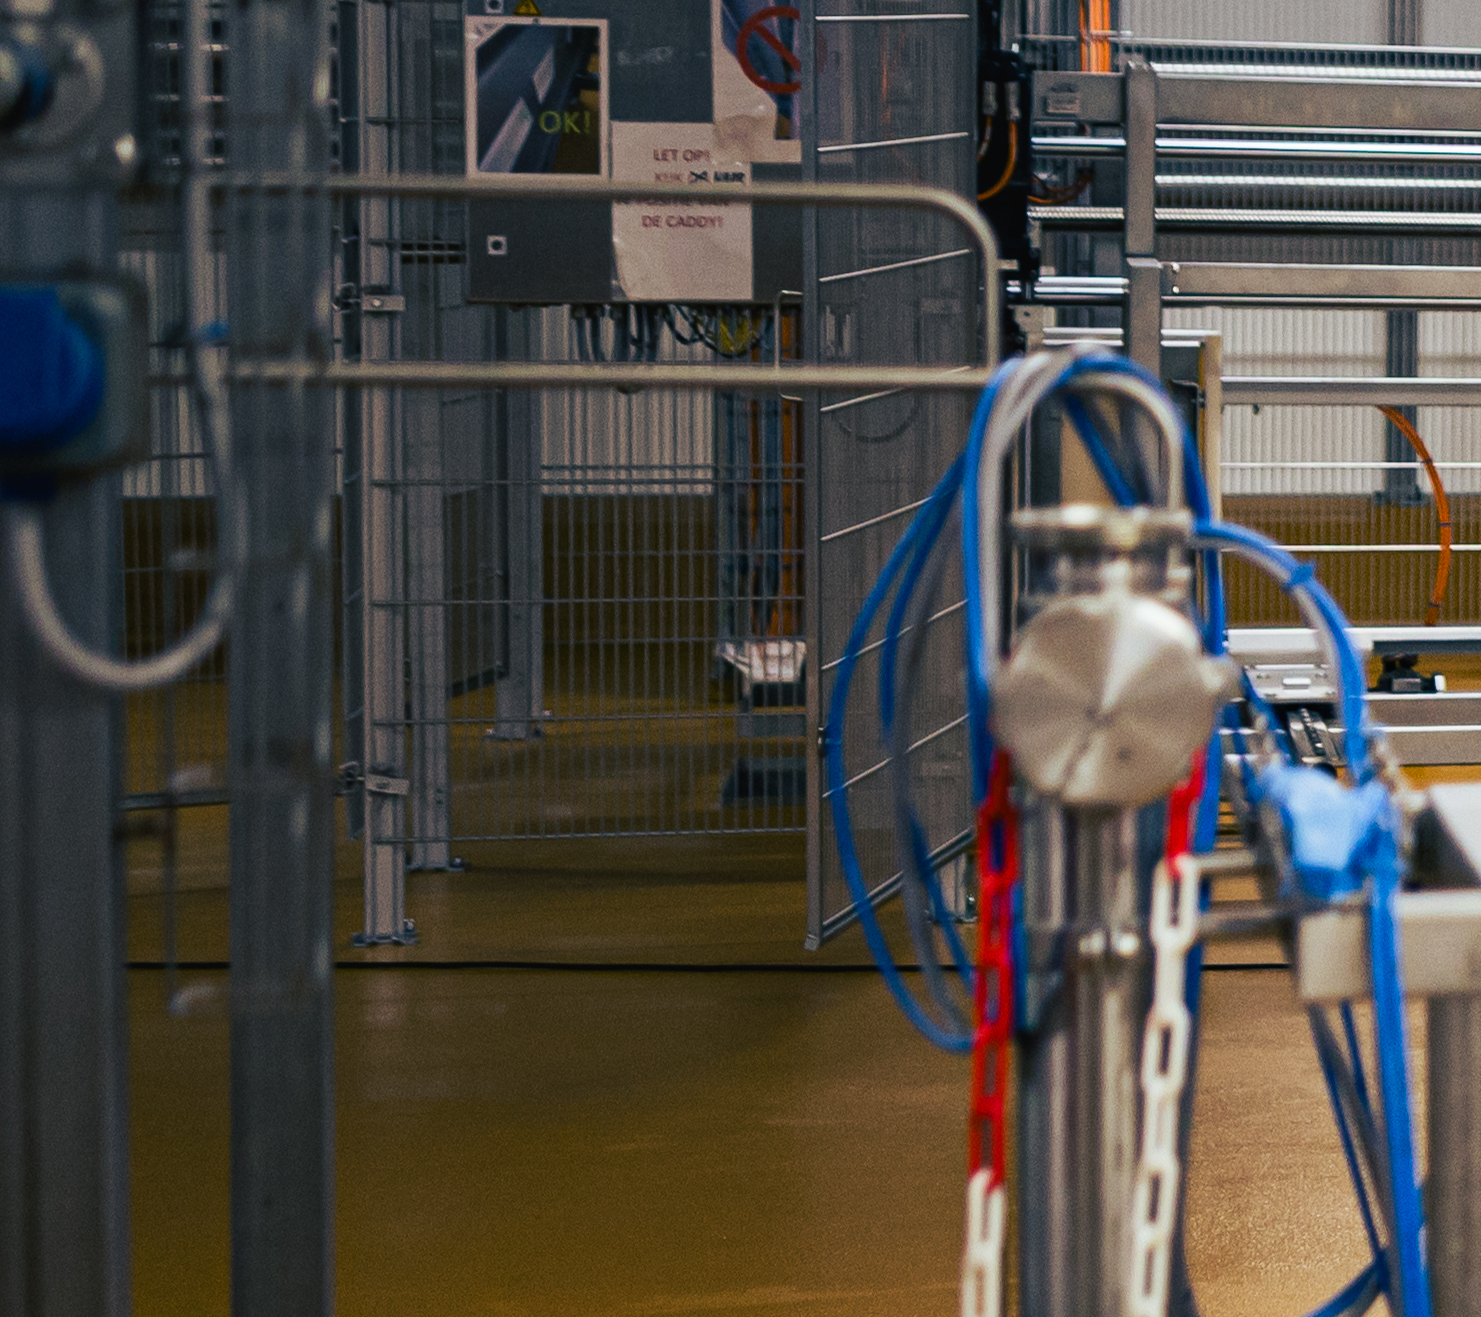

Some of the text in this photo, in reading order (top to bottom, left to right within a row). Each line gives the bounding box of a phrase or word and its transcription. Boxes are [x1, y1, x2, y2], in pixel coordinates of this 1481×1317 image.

[539, 110, 592, 135] OK!
[653, 148, 678, 162] LET
[641, 215, 661, 228] DE
